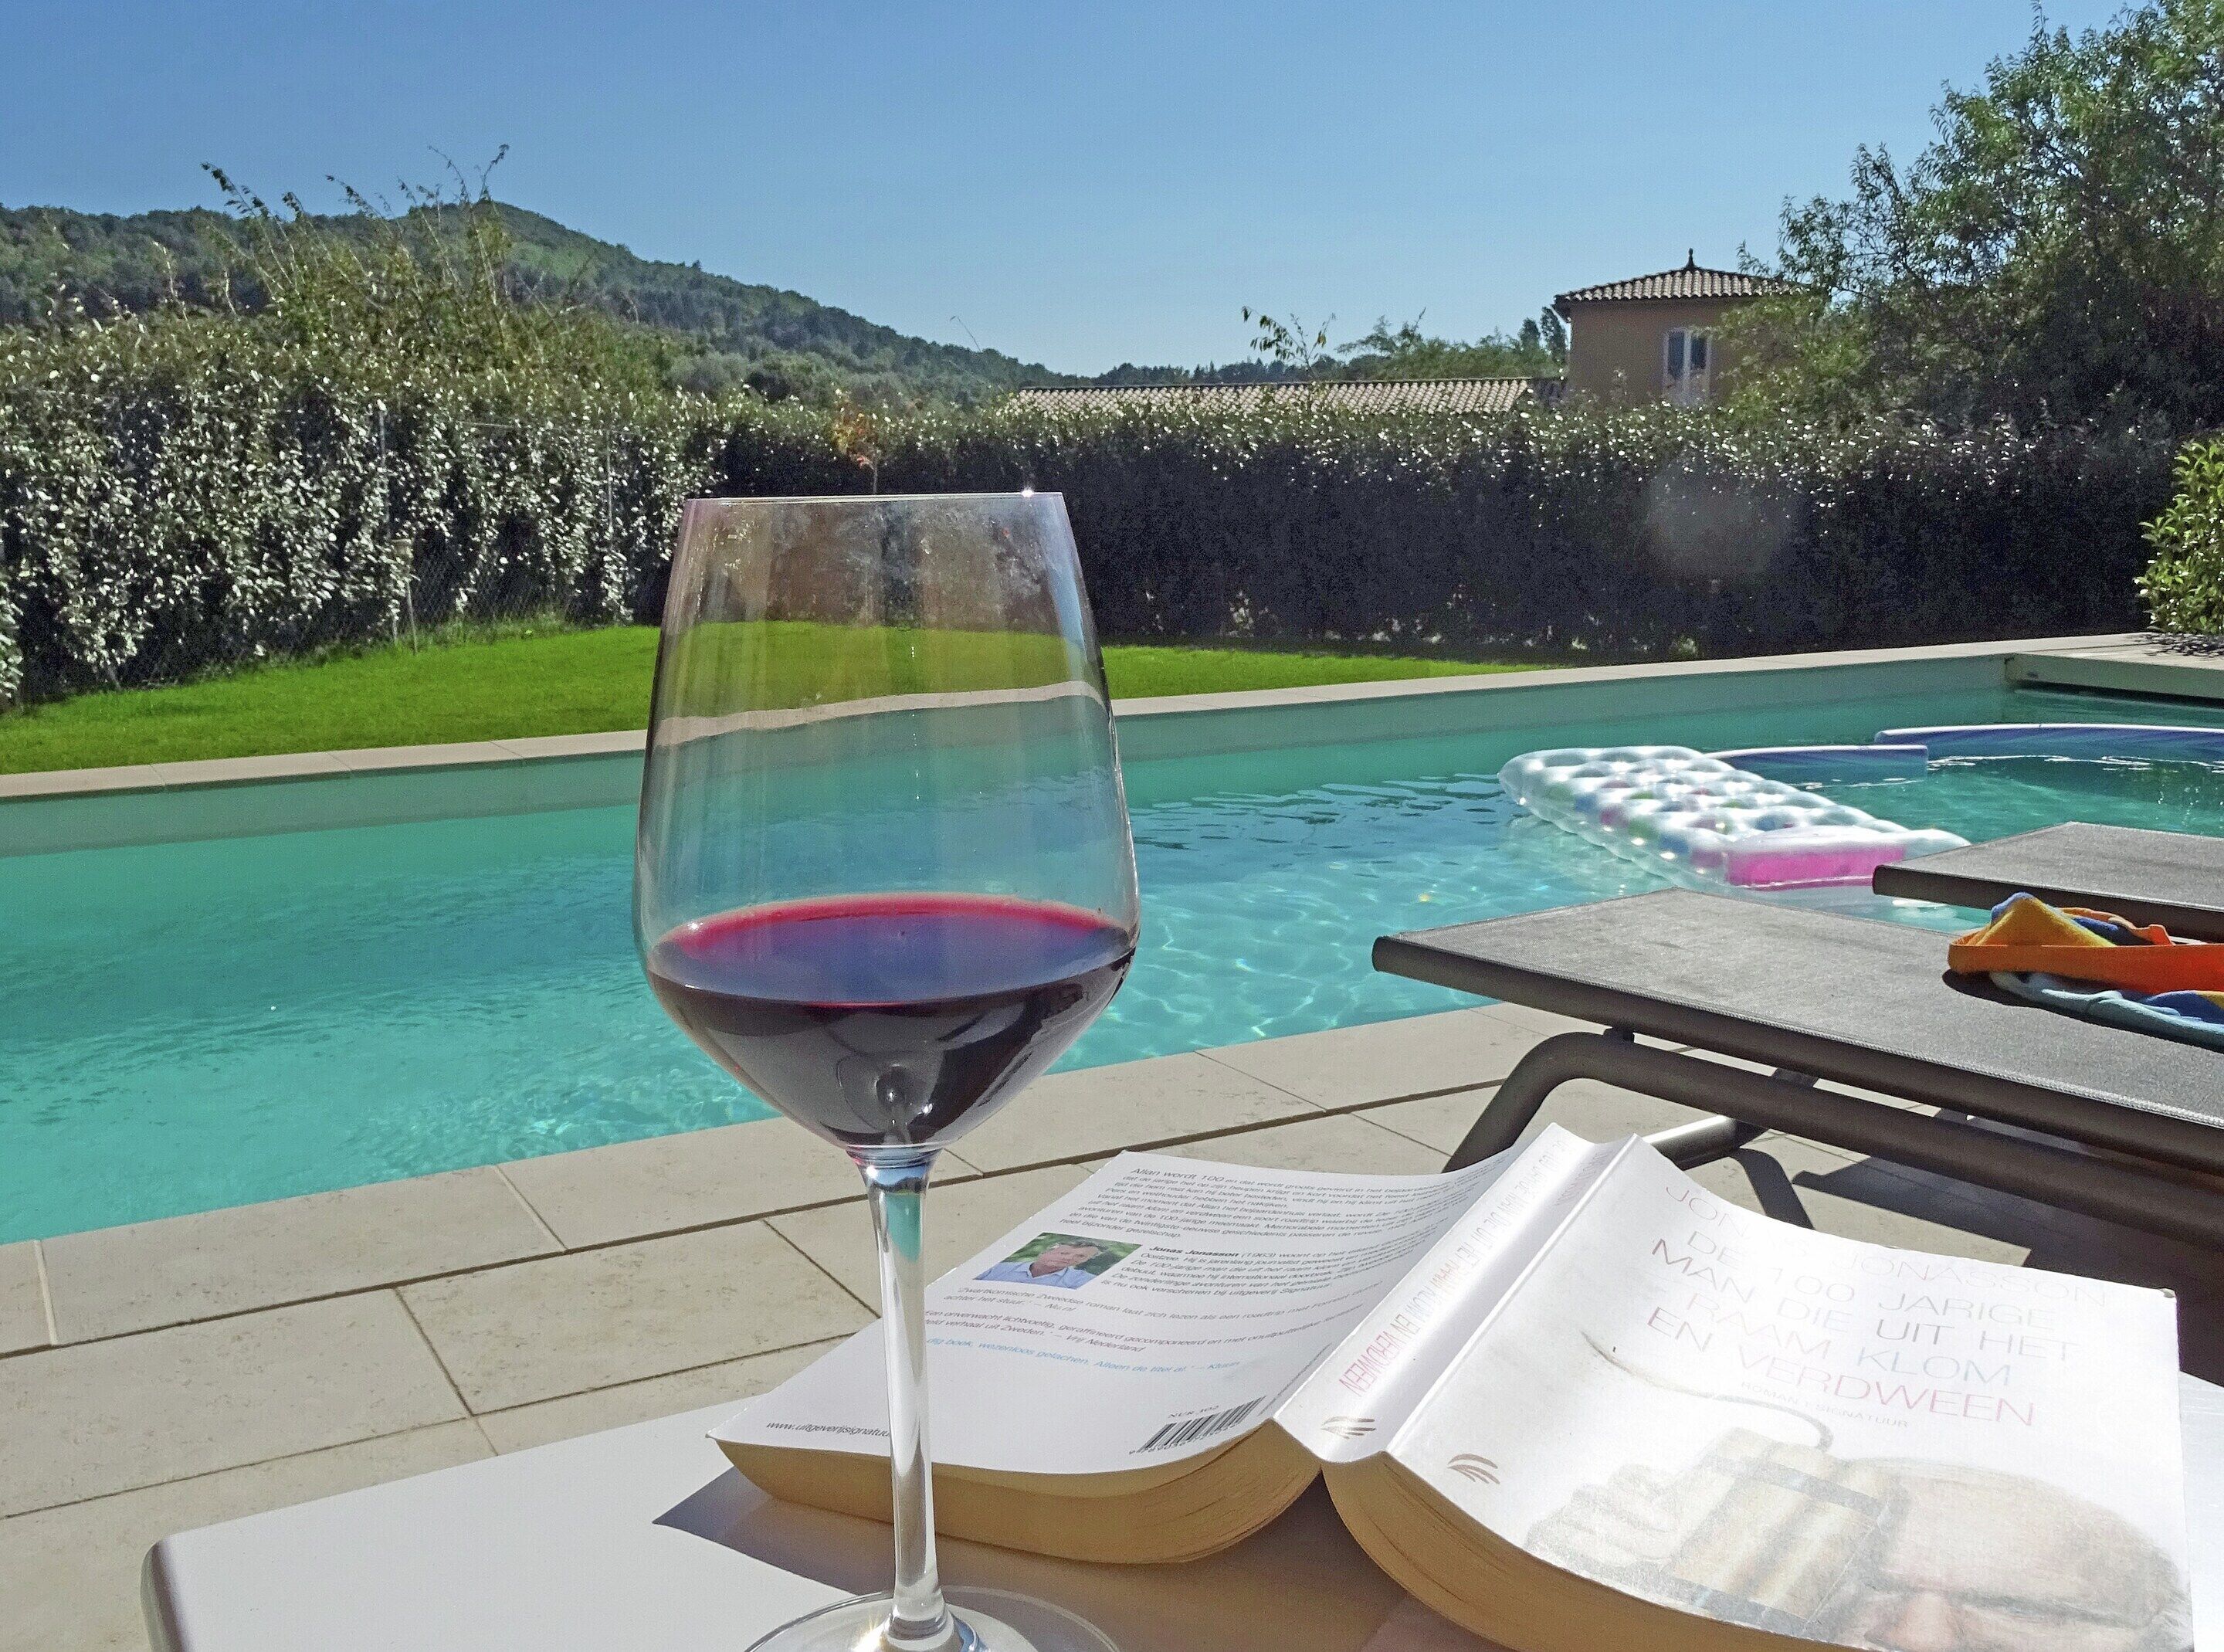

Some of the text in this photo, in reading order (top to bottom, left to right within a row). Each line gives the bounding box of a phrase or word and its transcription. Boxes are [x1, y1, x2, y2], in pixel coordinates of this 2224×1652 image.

[1131, 1168, 1160, 1176] Allan
[1152, 1287, 1211, 1295] verschenen
[1687, 1230, 1740, 1270] DE
[1878, 1293, 2056, 1332] JARIGE
[1086, 1301, 1120, 1311] roman
[1652, 1238, 2081, 1362] MAN DIE UIT HET
[944, 1311, 1002, 1320] onverwacht
[1003, 1315, 1055, 1328] lichtvoetig,
[1059, 1325, 1125, 1339] geraffineerd
[1390, 1314, 1421, 1339] EN
[1085, 1338, 1146, 1352] Nederland
[1687, 1292, 2011, 1386] RAAM KLOM
[1094, 1361, 1129, 1370] Alleen
[1339, 1331, 1407, 1398] VERDWEEN
[1647, 1306, 2035, 1426] EN VERDWEEN
[766, 1422, 890, 1436] www.uitgeverijsignatuu
